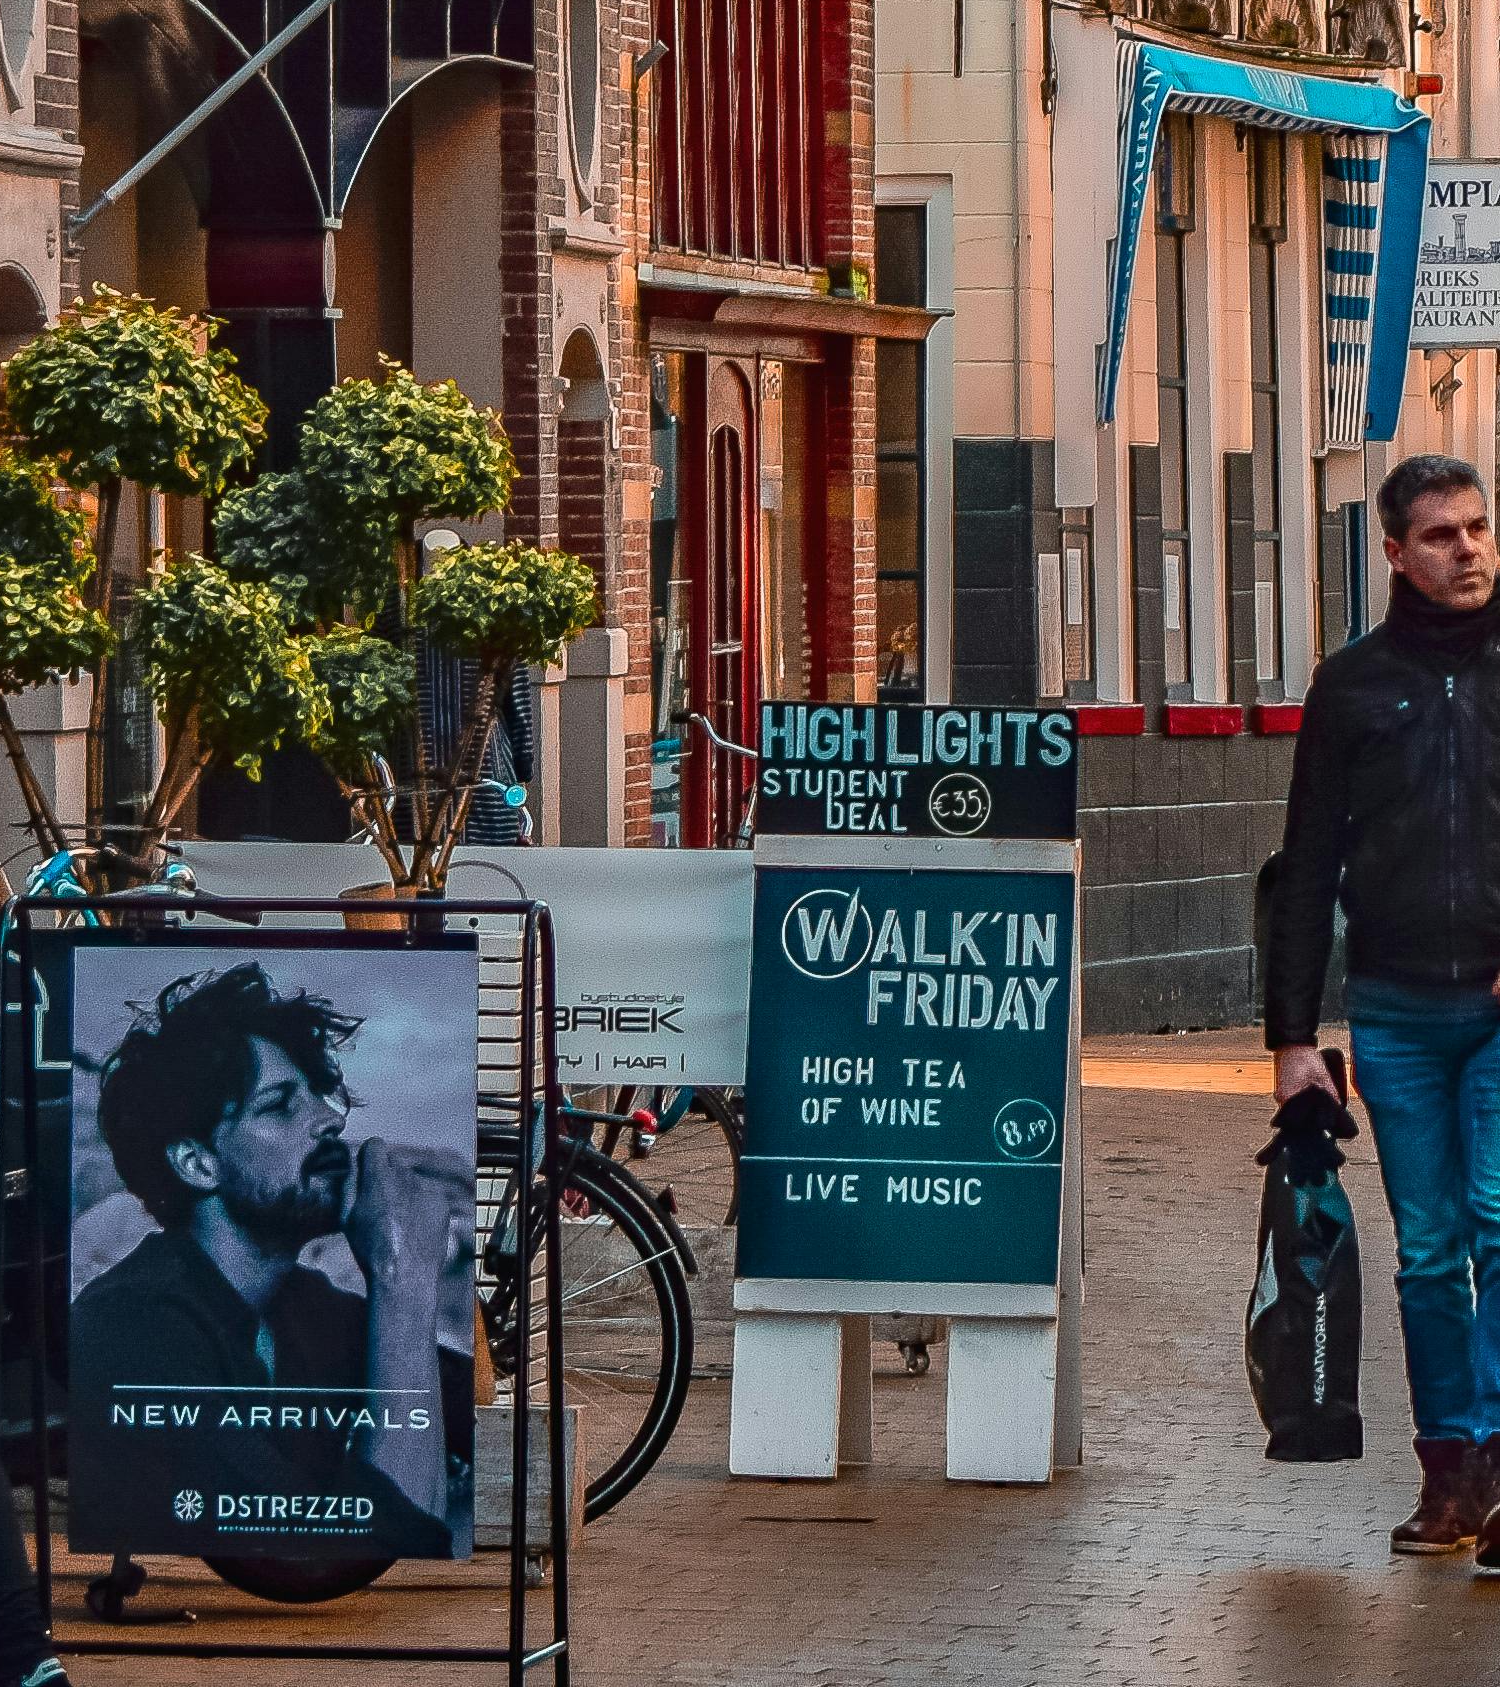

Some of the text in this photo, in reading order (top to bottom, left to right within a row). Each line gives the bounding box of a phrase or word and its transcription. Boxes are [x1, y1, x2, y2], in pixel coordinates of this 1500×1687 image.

[1416, 270, 1480, 287] RIEKS
[763, 768, 909, 798] STUDENT
[826, 801, 908, 832] DEAL
[867, 970, 1059, 1030] FRIDAY
[555, 1006, 685, 1034] BRIEK
[613, 1055, 667, 1069] HAIR
[801, 1056, 966, 1089] HIGH TEA
[801, 1097, 942, 1127] OF WINE
[786, 1173, 983, 1206] LIVE MUSIC
[112, 1404, 431, 1430] NEW ARRIVALS
[218, 1494, 374, 1520] DSTREZZED
